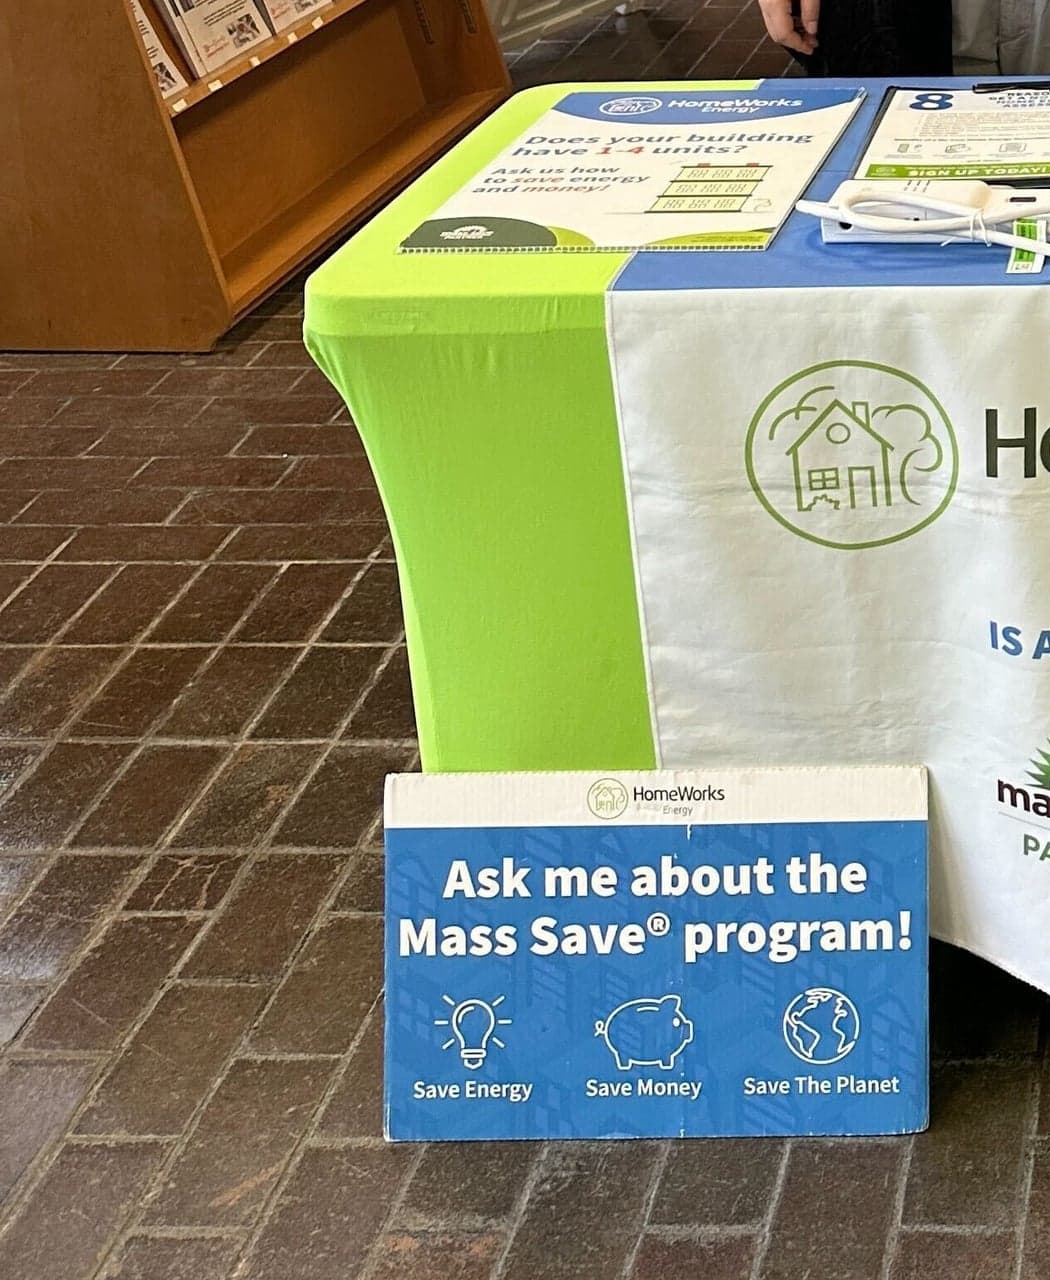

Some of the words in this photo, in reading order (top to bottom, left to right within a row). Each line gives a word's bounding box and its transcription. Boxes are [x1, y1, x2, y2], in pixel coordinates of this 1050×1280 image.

[668, 98, 804, 108] HomeWorks
[909, 93, 954, 110] 8
[701, 106, 761, 114] Energy
[524, 136, 601, 145] Does
[605, 136, 681, 146] your
[686, 133, 816, 144] building
[512, 147, 589, 156] have
[595, 146, 645, 155] 1-4
[652, 145, 748, 154] units?
[491, 167, 534, 175] Ask
[908, 168, 952, 177] SIGN
[979, 166, 1048, 174] TODAY!
[569, 175, 652, 184] energy
[521, 184, 612, 193] money!
[989, 621, 1023, 657] IS
[633, 784, 725, 801] HomeWorks
[663, 805, 693, 816] Energy
[442, 857, 531, 899] Ask
[544, 865, 617, 898] me
[630, 855, 775, 897] about
[785, 852, 868, 893] the
[399, 918, 517, 957] Mass
[683, 910, 913, 963] program!
[413, 1080, 462, 1099] Save
[466, 1080, 533, 1102] Energy
[585, 1078, 634, 1098] Save
[637, 1078, 702, 1100] Money
[744, 1076, 792, 1096] Save
[796, 1075, 831, 1095] The
[836, 1075, 900, 1095] Planet
